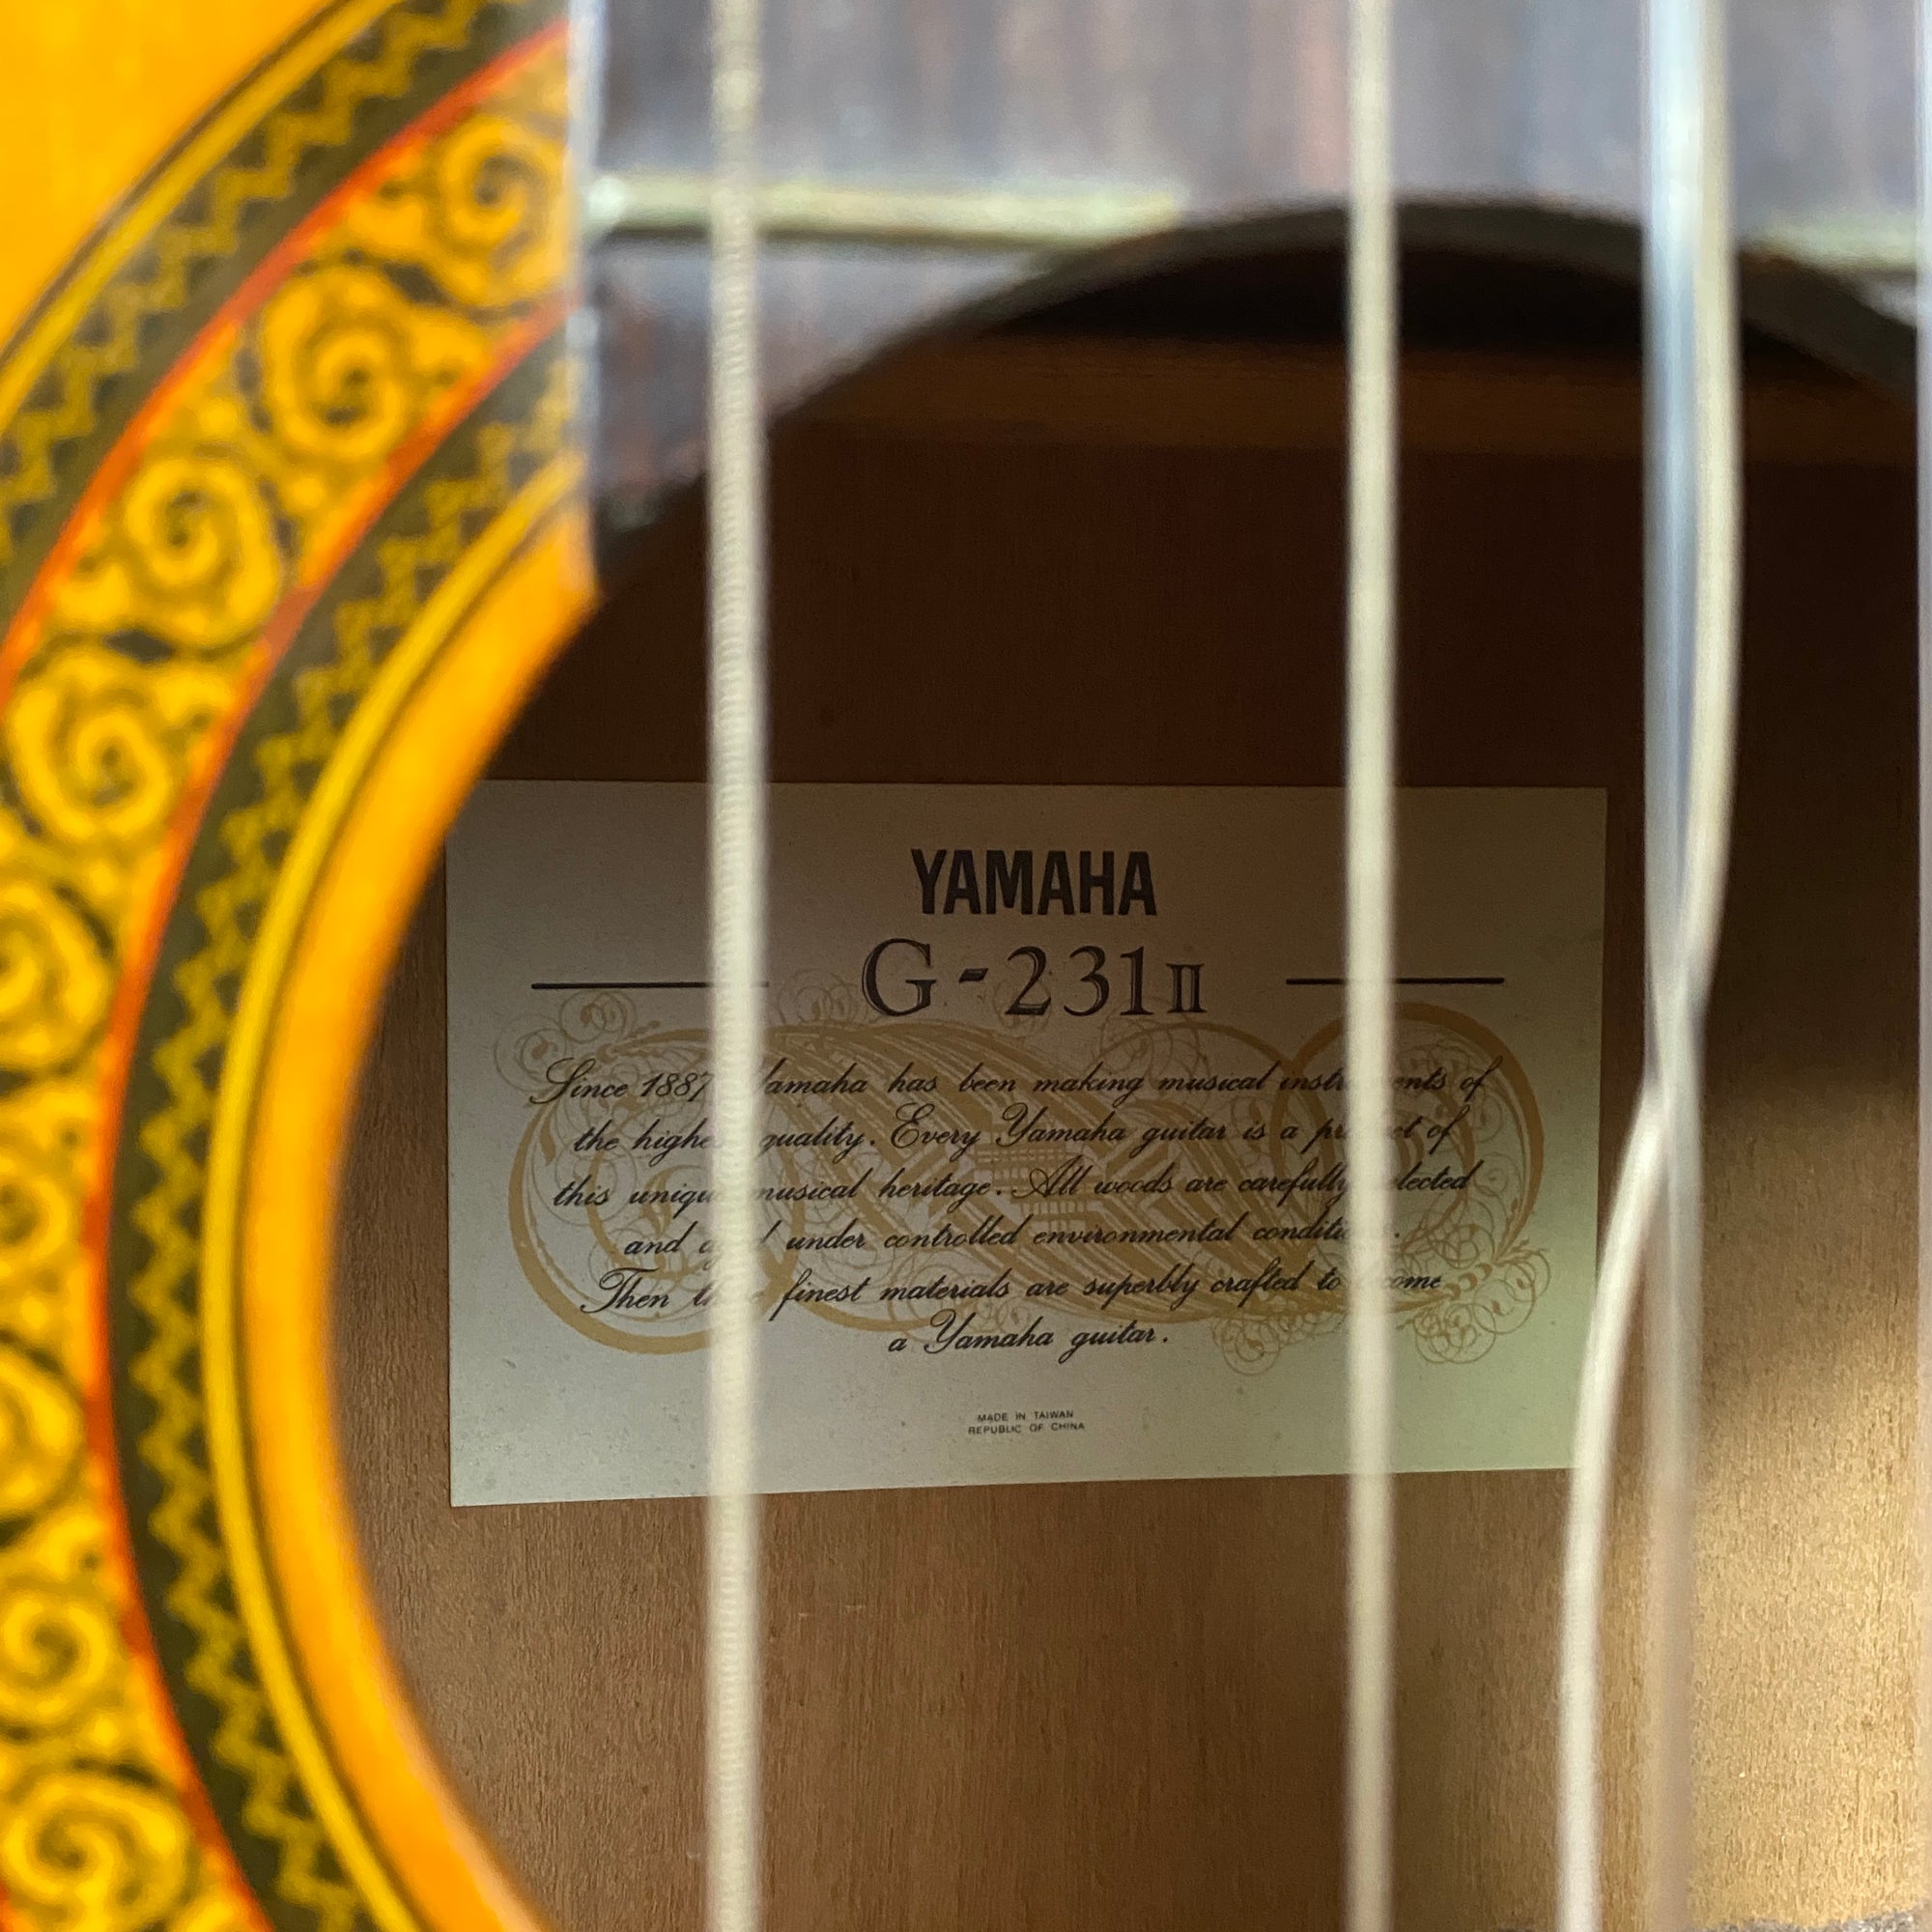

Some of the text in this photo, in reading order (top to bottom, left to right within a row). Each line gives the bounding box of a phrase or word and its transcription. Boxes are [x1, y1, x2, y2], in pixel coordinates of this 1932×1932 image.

[911, 848, 1157, 916] YAMAHA
[529, 1057, 628, 1104] Since
[887, 1063, 937, 1093] has
[958, 1063, 1016, 1093] been
[1033, 1062, 1144, 1108] making
[1158, 1060, 1281, 1091] musical
[1279, 1066, 1446, 1092] instrents
[1460, 1056, 1503, 1102] of
[574, 1119, 618, 1151] the
[632, 1118, 721, 1167] highe
[891, 1101, 981, 1162] Every
[996, 1101, 1127, 1148] Yamaha
[1129, 1117, 1226, 1158] guitar
[1242, 1121, 1265, 1140] is
[1280, 1124, 1299, 1140] a
[1300, 1115, 1424, 1154] prct
[1427, 1104, 1470, 1155] of
[554, 1175, 610, 1207] this
[629, 1183, 716, 1219] uniqu
[878, 1167, 1002, 1213] heritage.
[1011, 1154, 1094, 1199] All
[1094, 1162, 1175, 1194] woods
[1185, 1179, 1228, 1193] are
[1390, 1159, 1485, 1191] lected
[624, 1221, 697, 1255] and
[786, 1217, 866, 1250] under
[884, 1214, 1034, 1249] controlled
[1033, 1211, 1249, 1244] environmental
[580, 1266, 668, 1313] Then
[768, 1268, 870, 1321] finest
[879, 1268, 1012, 1301] materials
[1026, 1281, 1069, 1296] are
[1083, 1263, 1200, 1311] superbly
[1210, 1257, 1315, 1308] crafted
[1318, 1266, 1341, 1291] to
[888, 1308, 1169, 1364] a Yamaha guitar.
[968, 1422, 1085, 1435] REPUBLIC OF CHINA
[978, 1409, 1073, 1422] MADE IN TAIWAN
